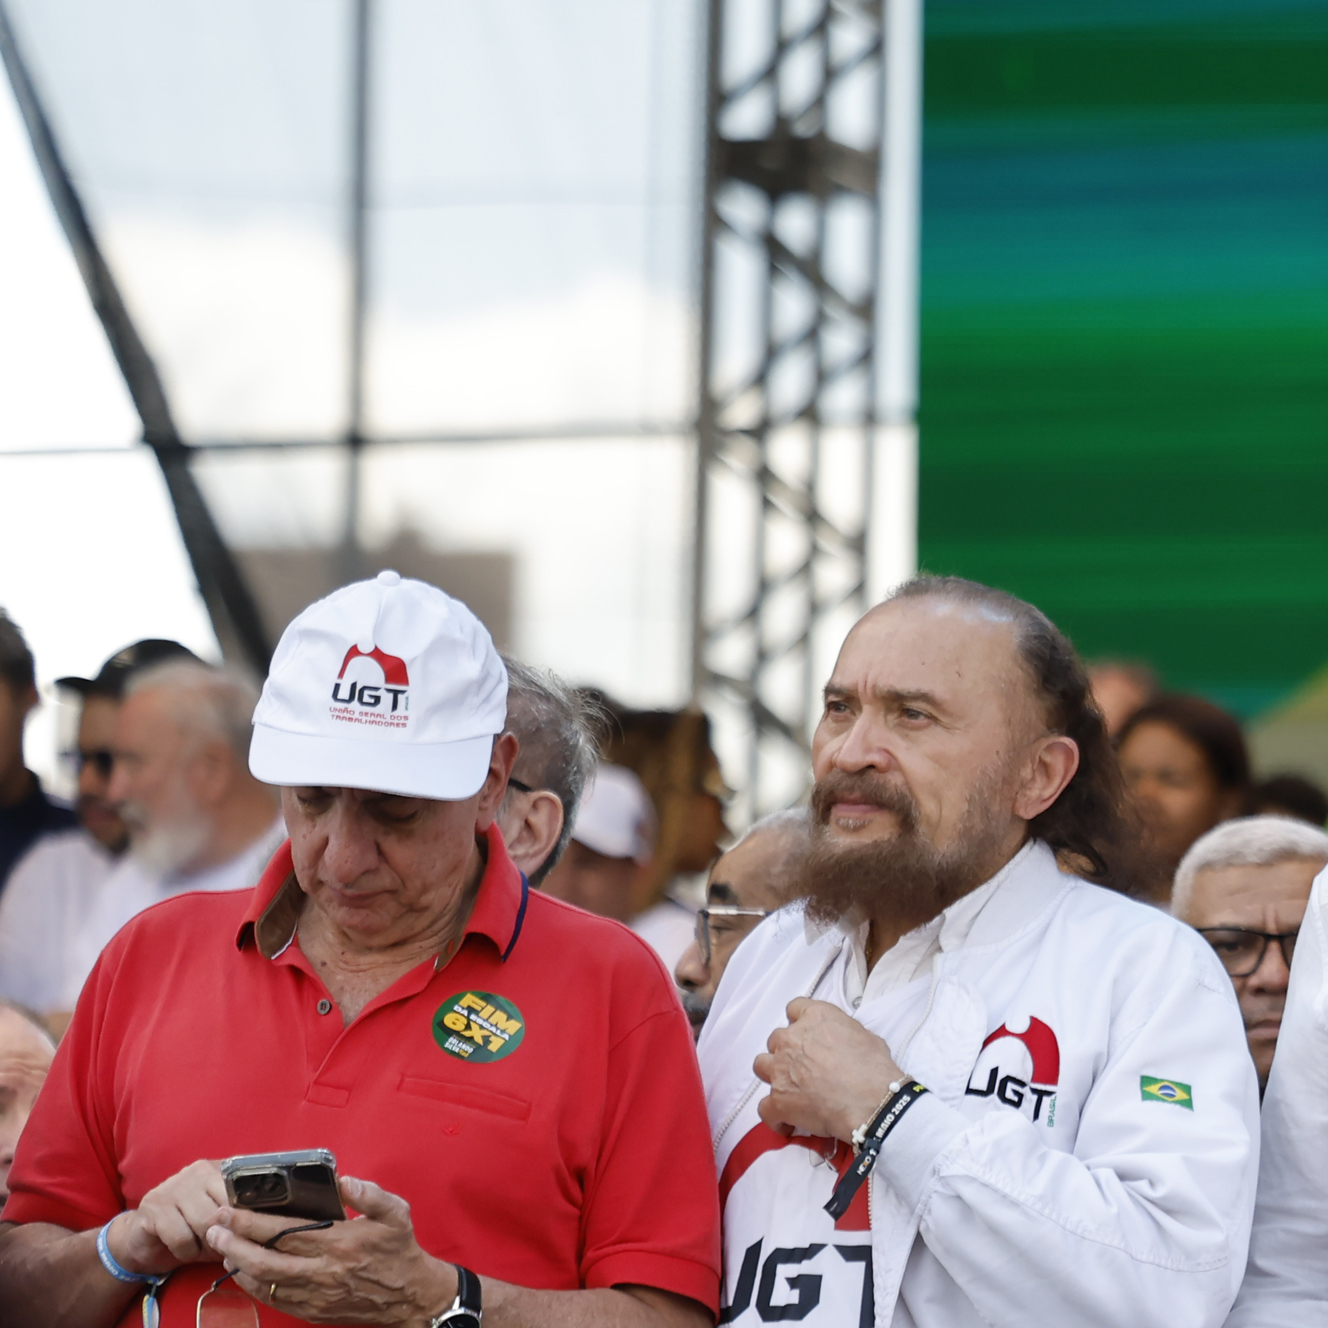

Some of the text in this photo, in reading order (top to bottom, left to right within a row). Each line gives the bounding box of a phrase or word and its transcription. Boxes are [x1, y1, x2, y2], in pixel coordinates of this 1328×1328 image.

[331, 681, 408, 713] UGT
[329, 706, 409, 722] UNIÃO GERAL DOS
[330, 714, 408, 729] TRABALHADORES
[453, 1004, 510, 1041] DA ESCALA
[458, 992, 523, 1036] FIM
[443, 1011, 507, 1054] 6X1
[447, 1036, 474, 1054] ORLANDO
[875, 1094, 912, 1139] MAIO 2025
[1046, 1095, 1057, 1128] BRASIL
